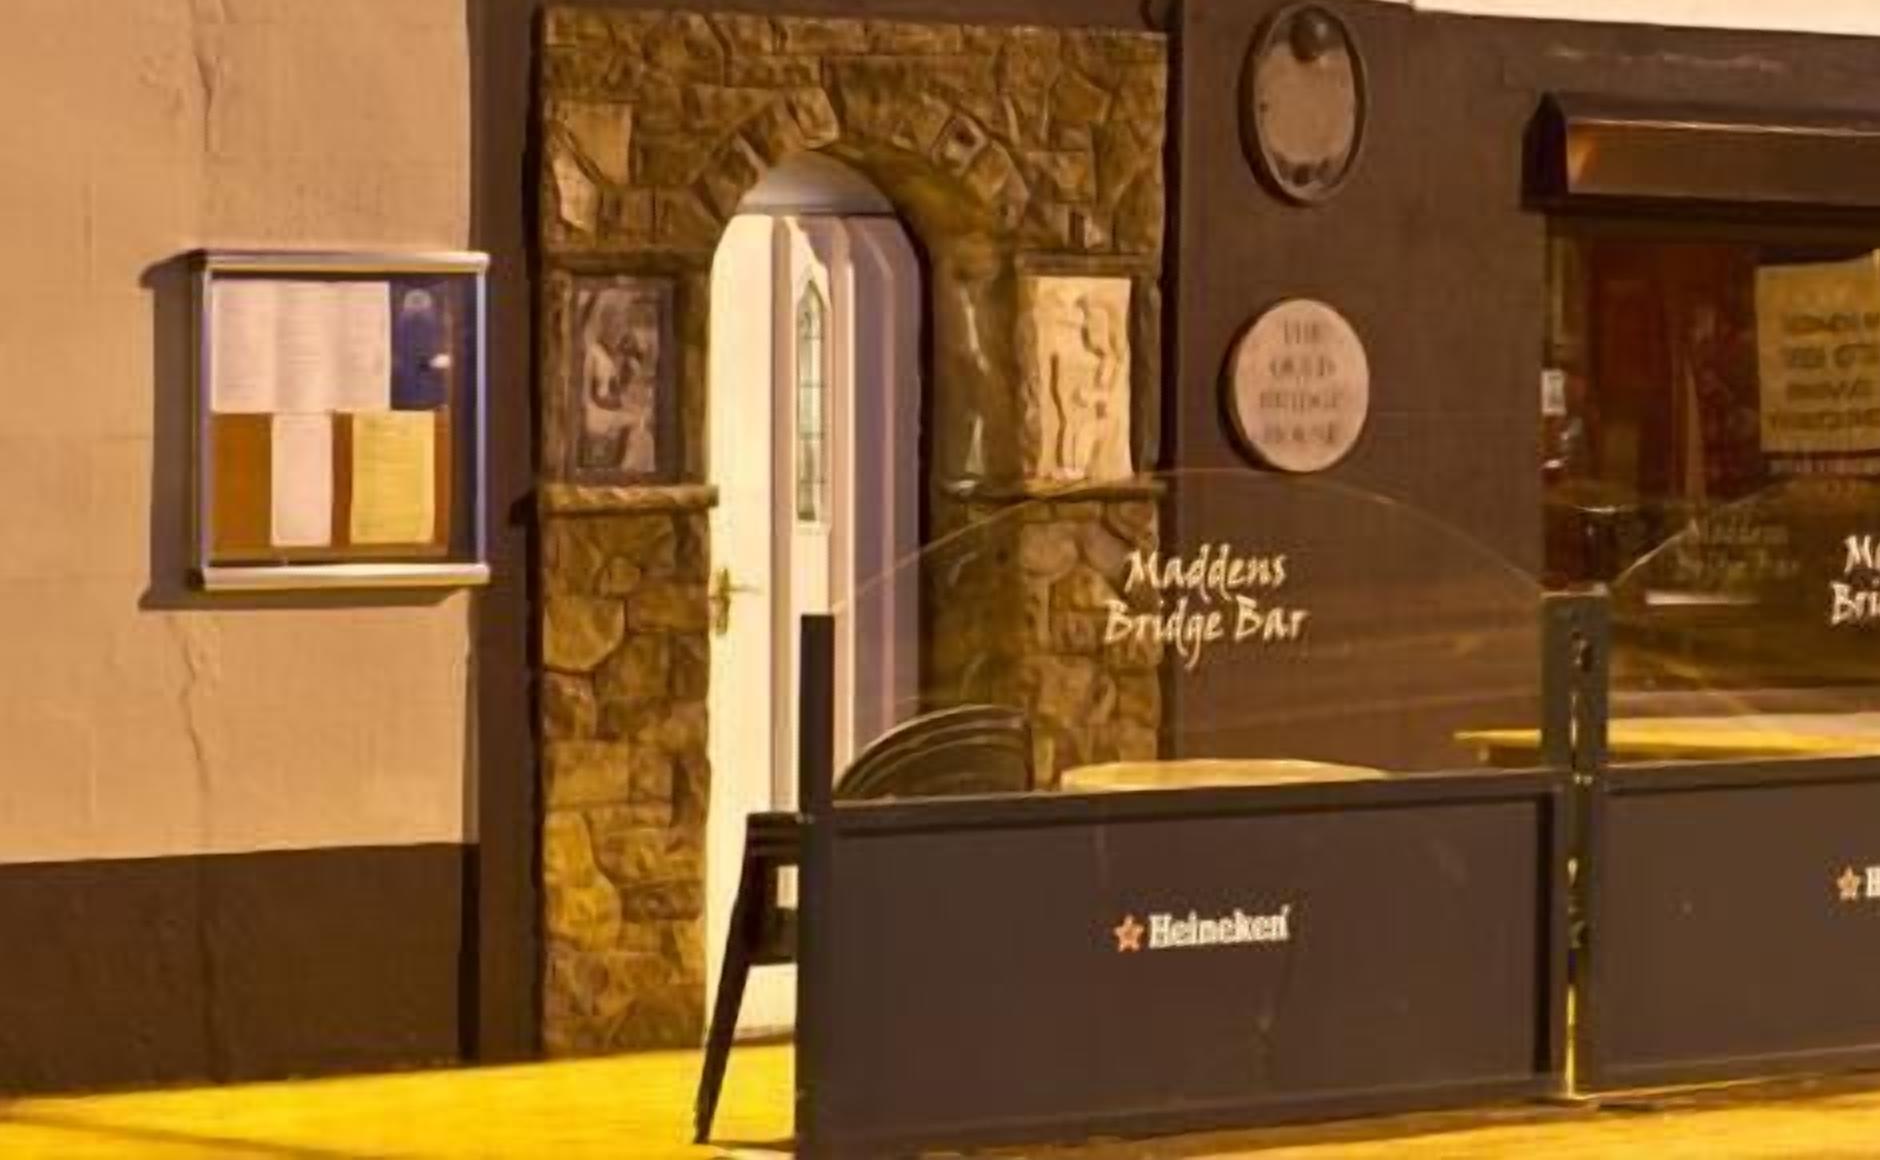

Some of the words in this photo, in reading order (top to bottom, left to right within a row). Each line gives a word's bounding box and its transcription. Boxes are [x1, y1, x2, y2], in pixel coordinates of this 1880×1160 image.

[1123, 543, 1287, 603] Maddens
[1104, 595, 1224, 670] Bridge
[1234, 594, 1310, 644] Bar
[1149, 904, 1291, 950] Heineken
